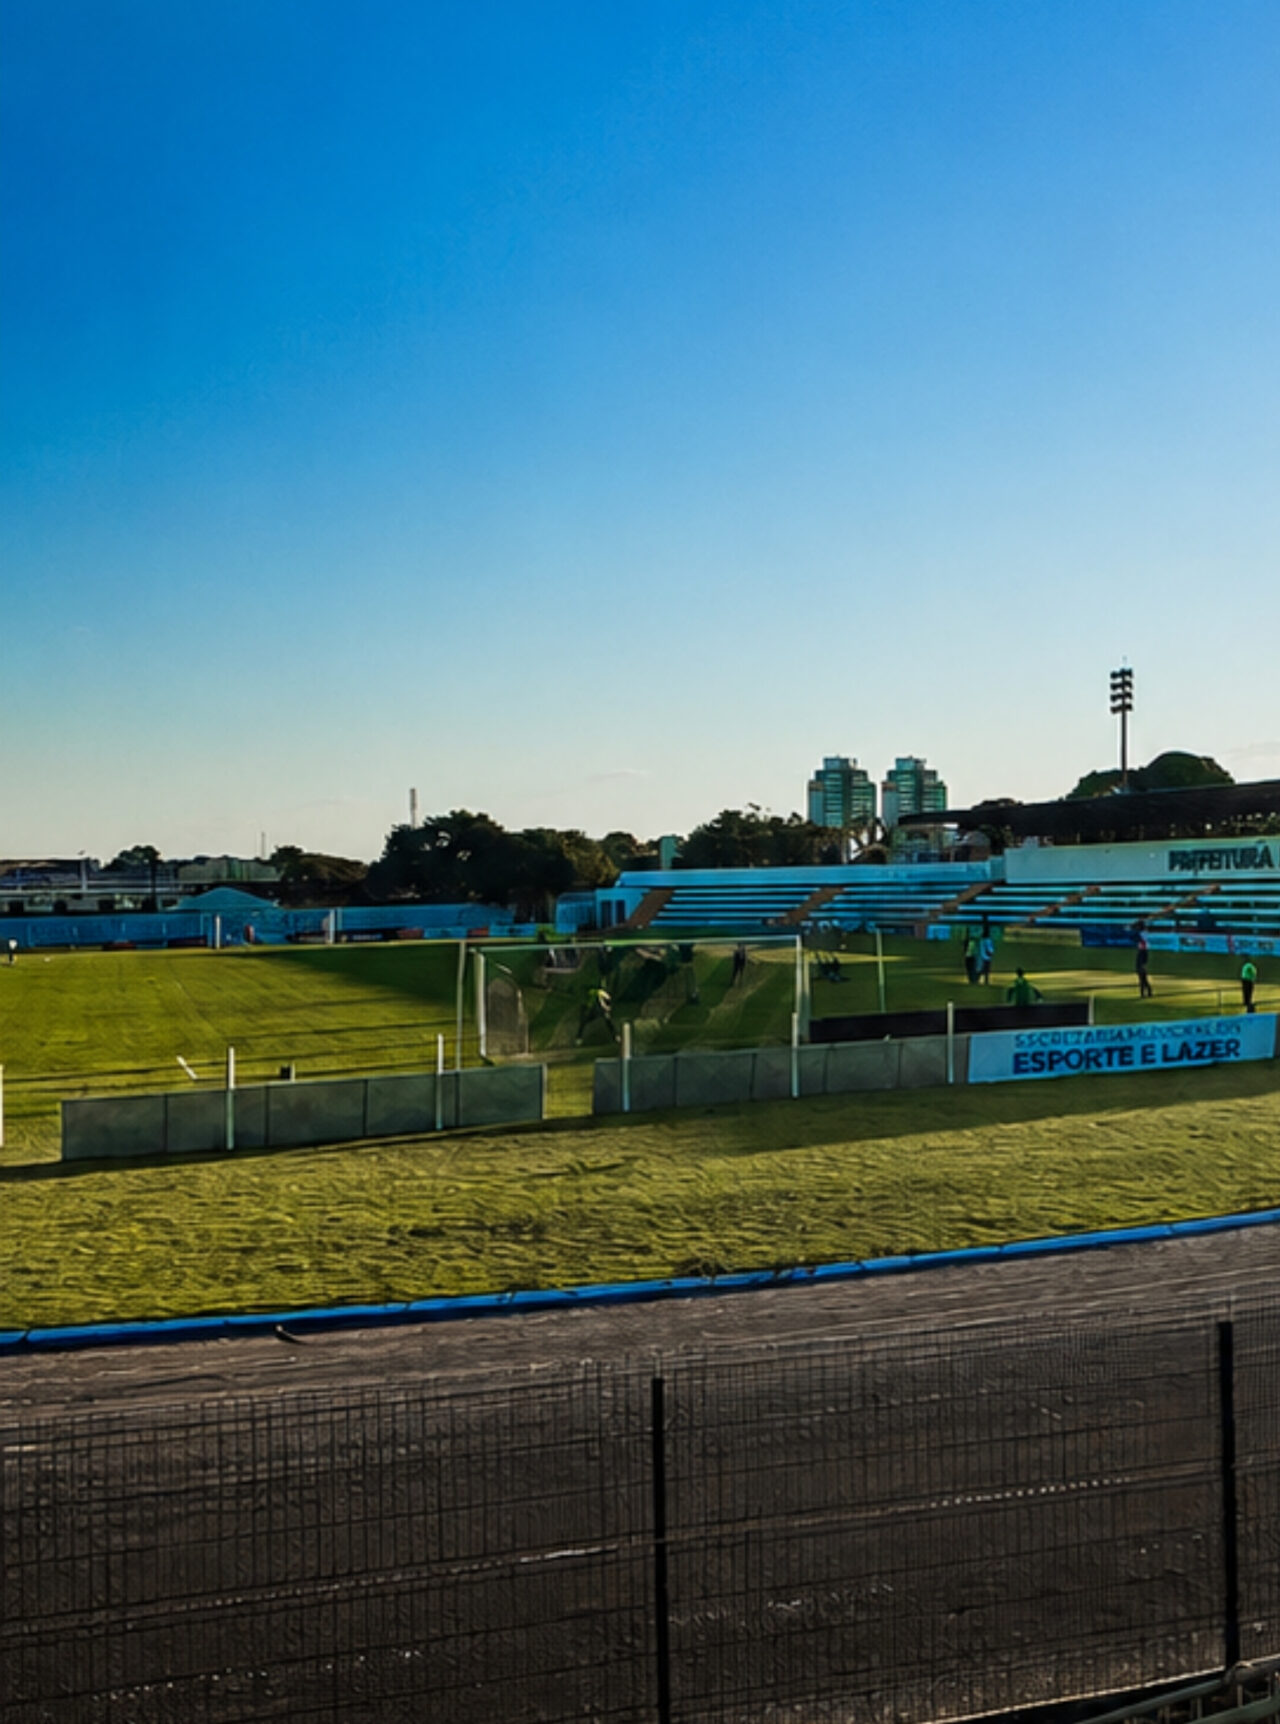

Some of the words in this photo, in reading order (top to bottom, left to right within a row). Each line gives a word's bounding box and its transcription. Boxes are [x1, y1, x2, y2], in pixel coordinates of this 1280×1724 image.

[1012, 1045, 1135, 1075] ESPORTE
[1140, 1043, 1157, 1065] E
[1162, 1039, 1241, 1063] LAZER
